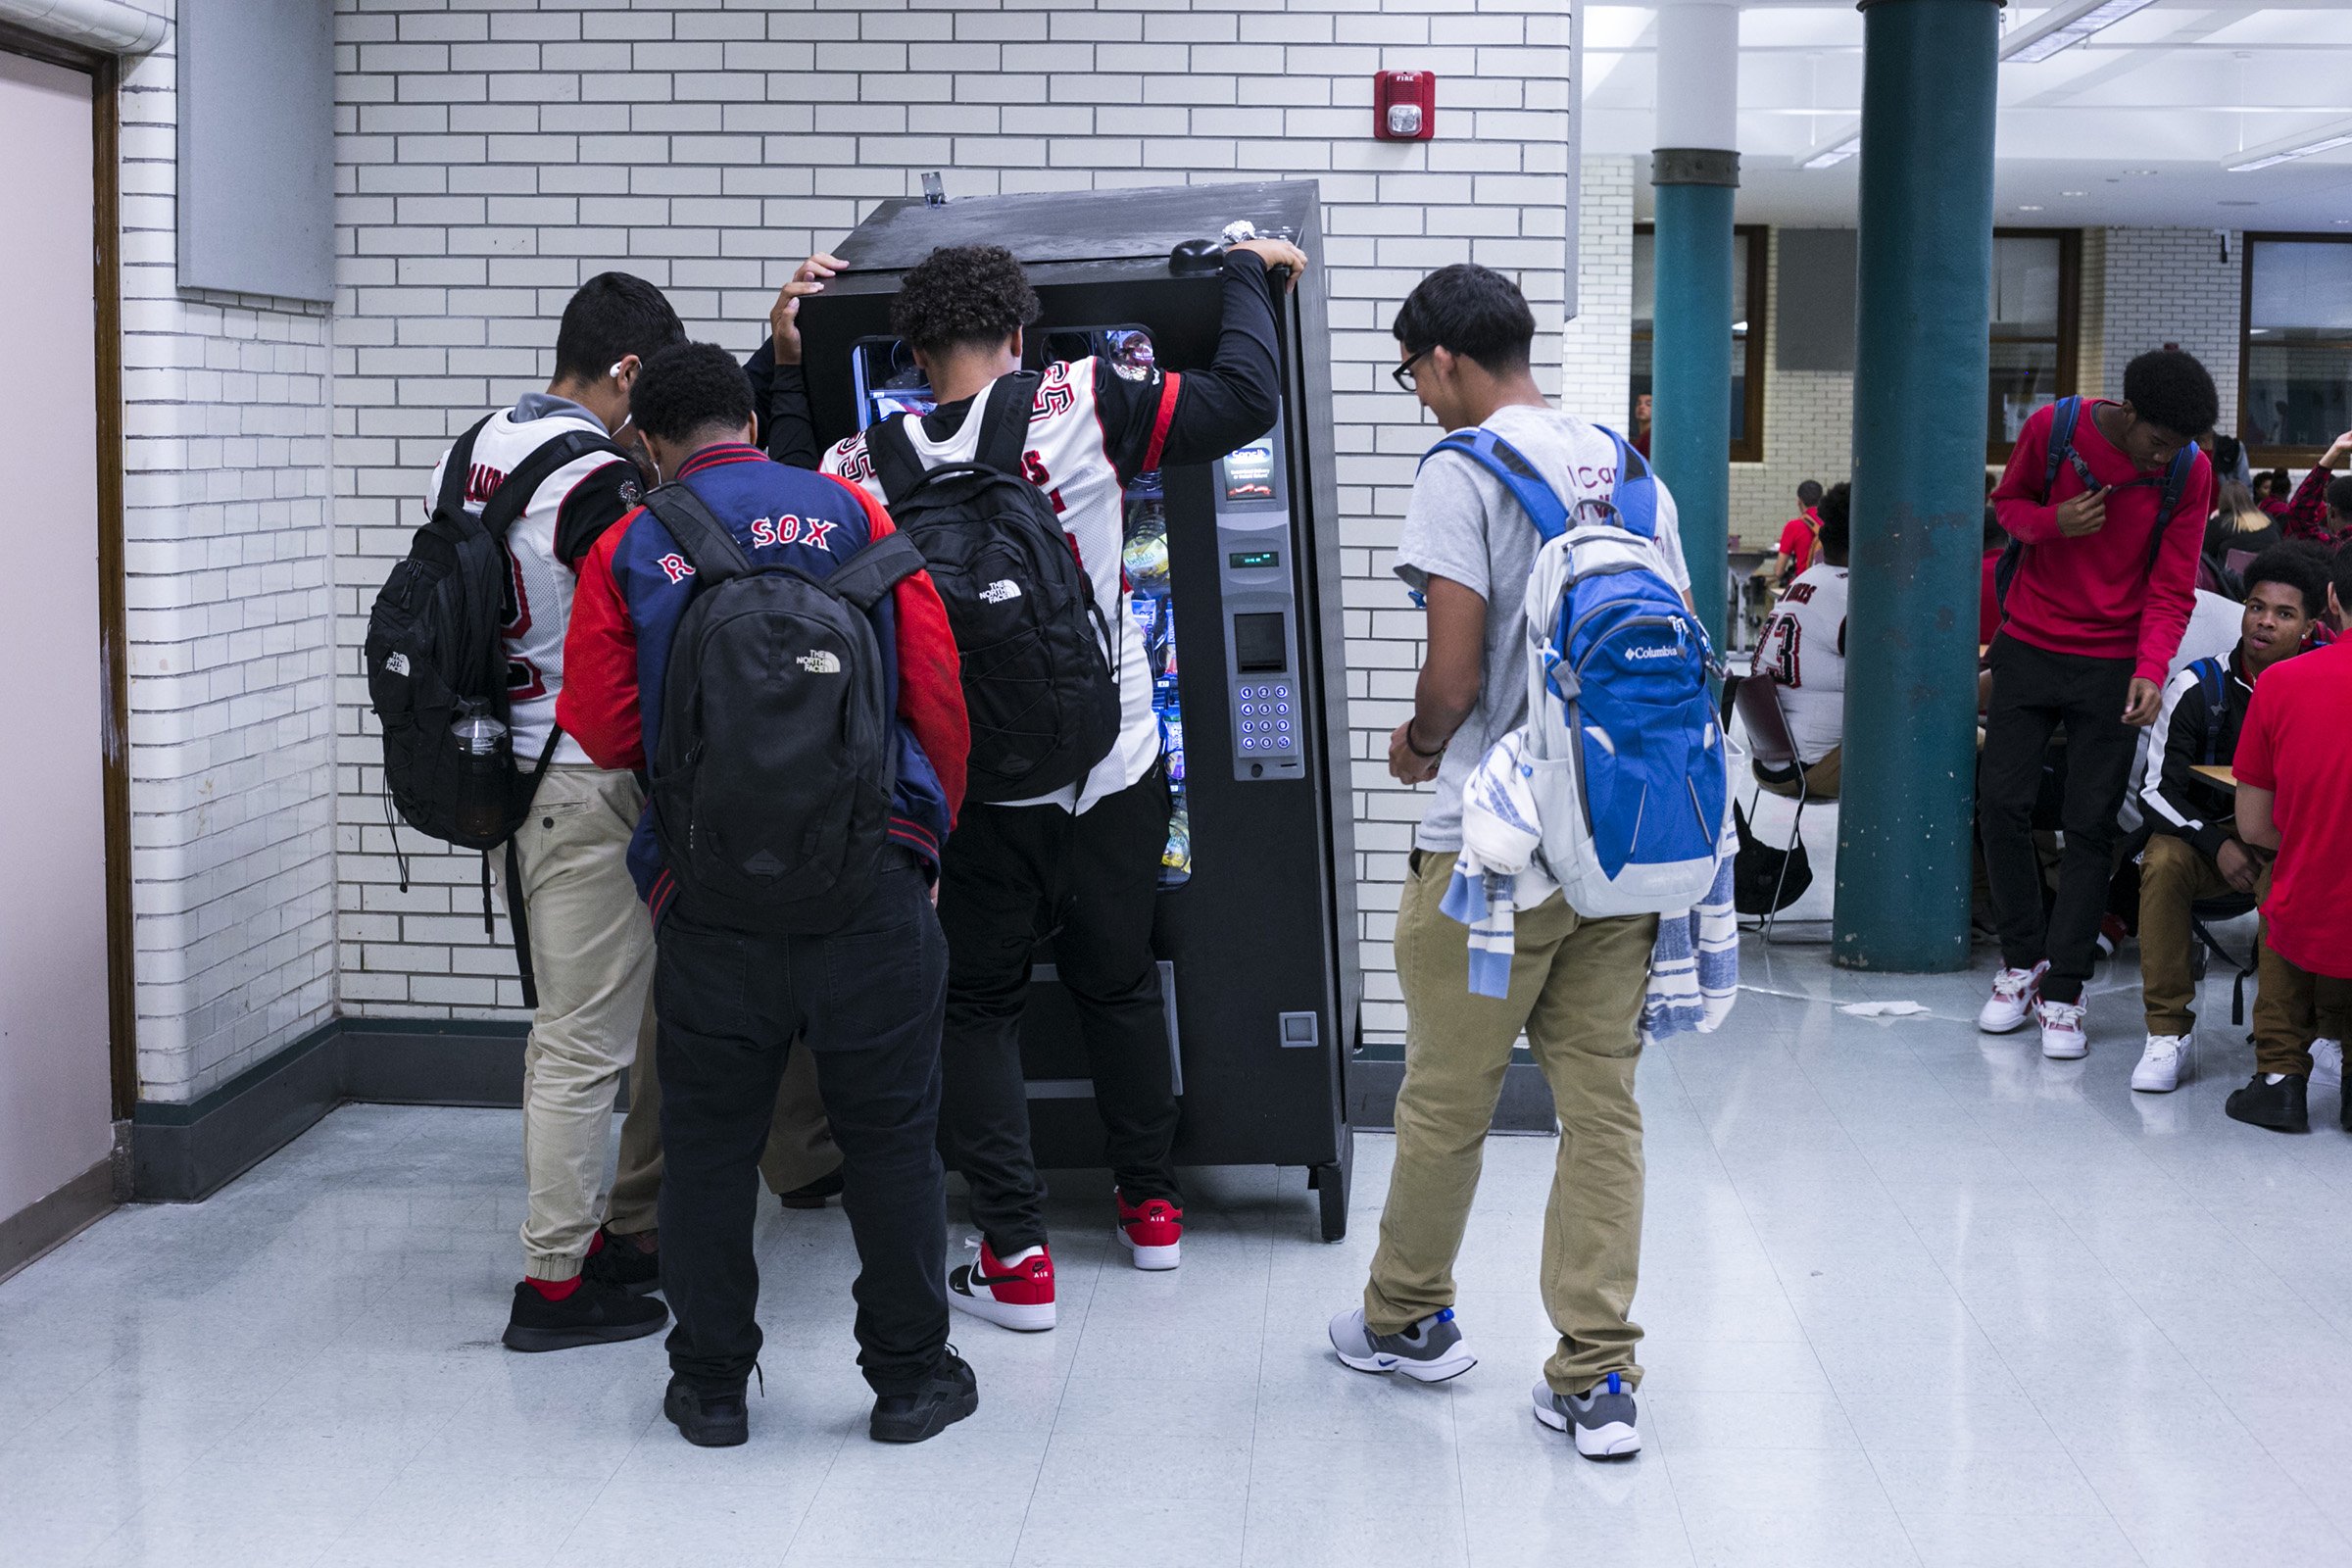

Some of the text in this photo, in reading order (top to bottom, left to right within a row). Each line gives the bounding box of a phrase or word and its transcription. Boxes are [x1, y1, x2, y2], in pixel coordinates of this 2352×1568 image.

[751, 514, 838, 552] SOX
[979, 588, 1005, 600] NORTH
[1635, 646, 1677, 659] Columbia
[796, 657, 824, 665] NORTH
